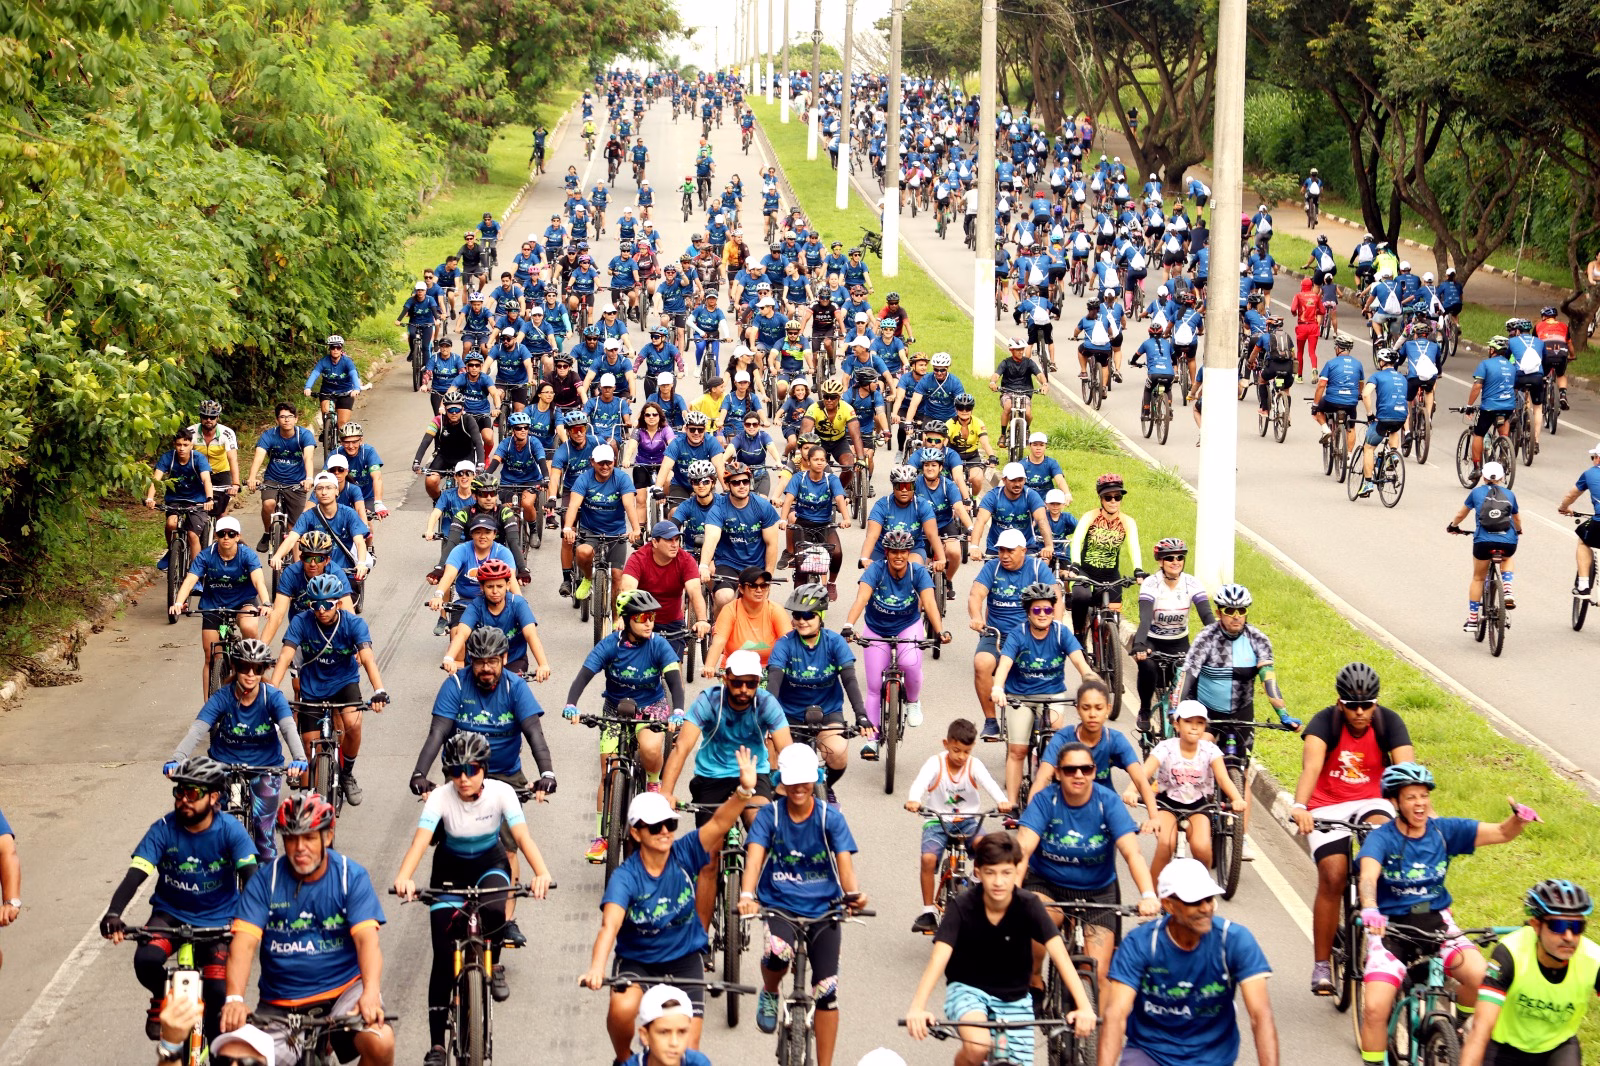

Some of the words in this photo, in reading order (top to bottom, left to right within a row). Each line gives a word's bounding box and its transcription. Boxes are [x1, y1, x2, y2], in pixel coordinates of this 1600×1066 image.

[1158, 613, 1186, 624] Argos
[1041, 849, 1080, 864] PEDALA
[269, 939, 316, 953] PEDALA
[1518, 993, 1576, 1013] PEDALA
